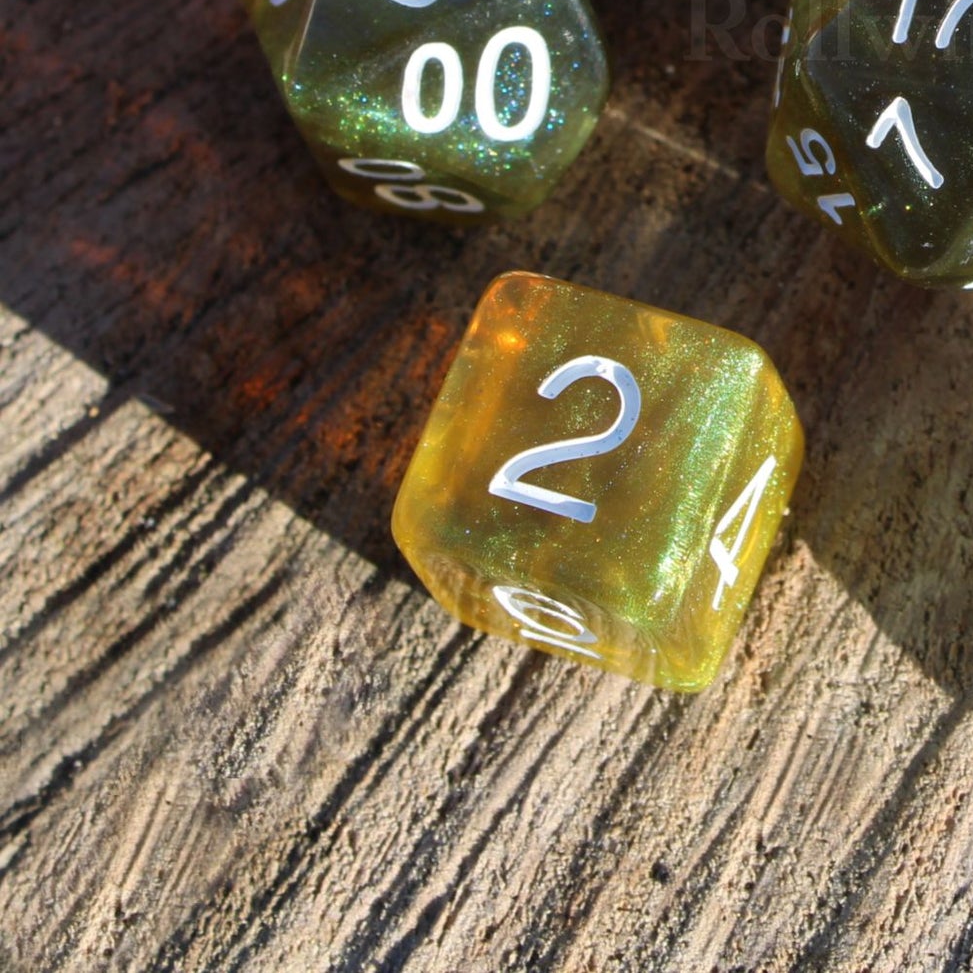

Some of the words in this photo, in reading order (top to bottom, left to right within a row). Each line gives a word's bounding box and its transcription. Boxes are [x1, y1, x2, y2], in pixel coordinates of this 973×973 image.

[401, 25, 552, 143] 00
[488, 355, 641, 524] 2
[709, 454, 777, 611] 4
